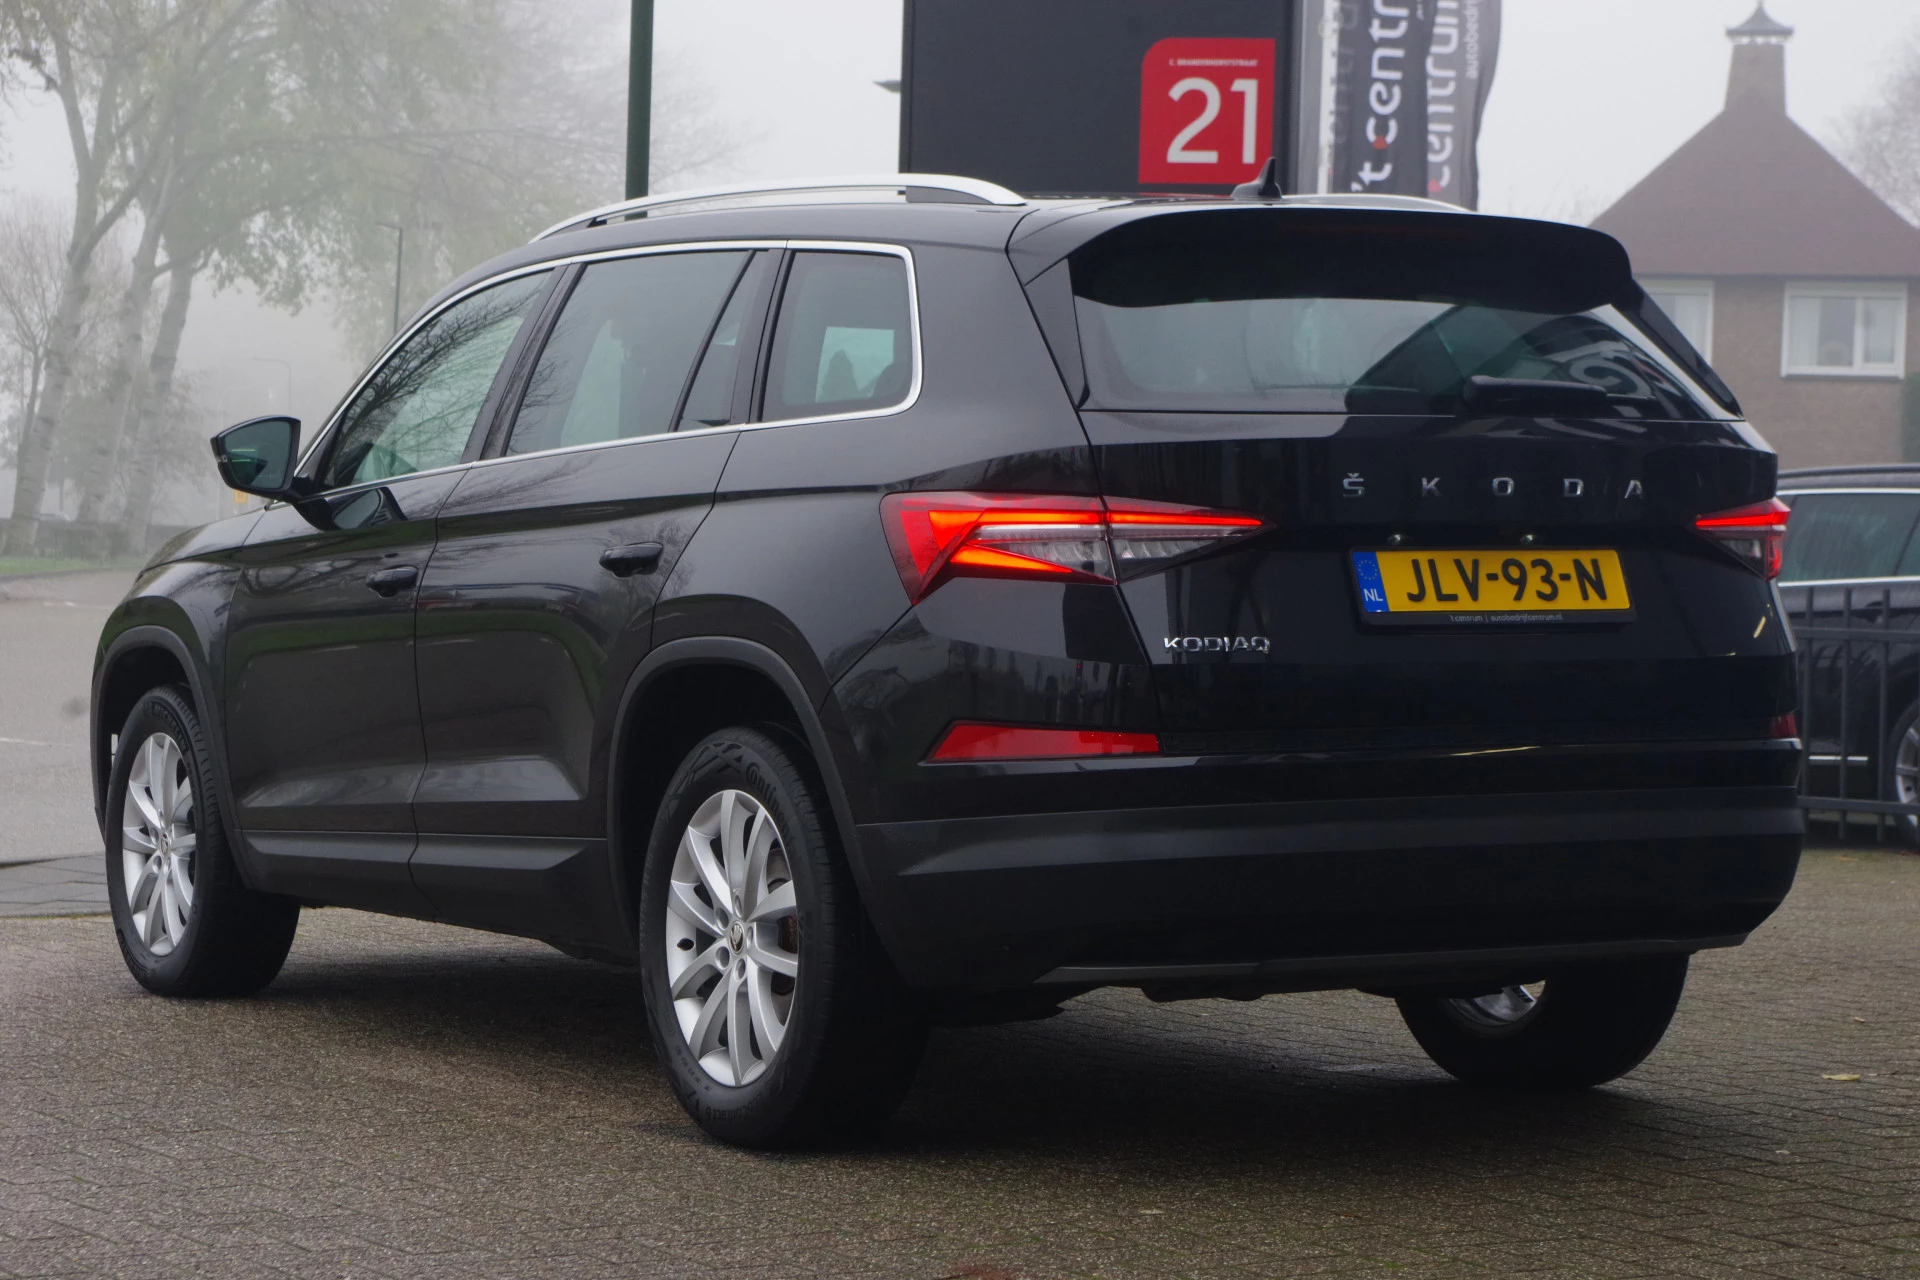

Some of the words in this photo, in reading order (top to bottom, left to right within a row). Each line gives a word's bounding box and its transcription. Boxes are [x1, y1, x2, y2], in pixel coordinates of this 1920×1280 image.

[1166, 77, 1259, 164] 21
[1407, 558, 1607, 601] JLV-93-N
[1364, 588, 1384, 602] NL
[1163, 636, 1271, 654] KODIAQ
